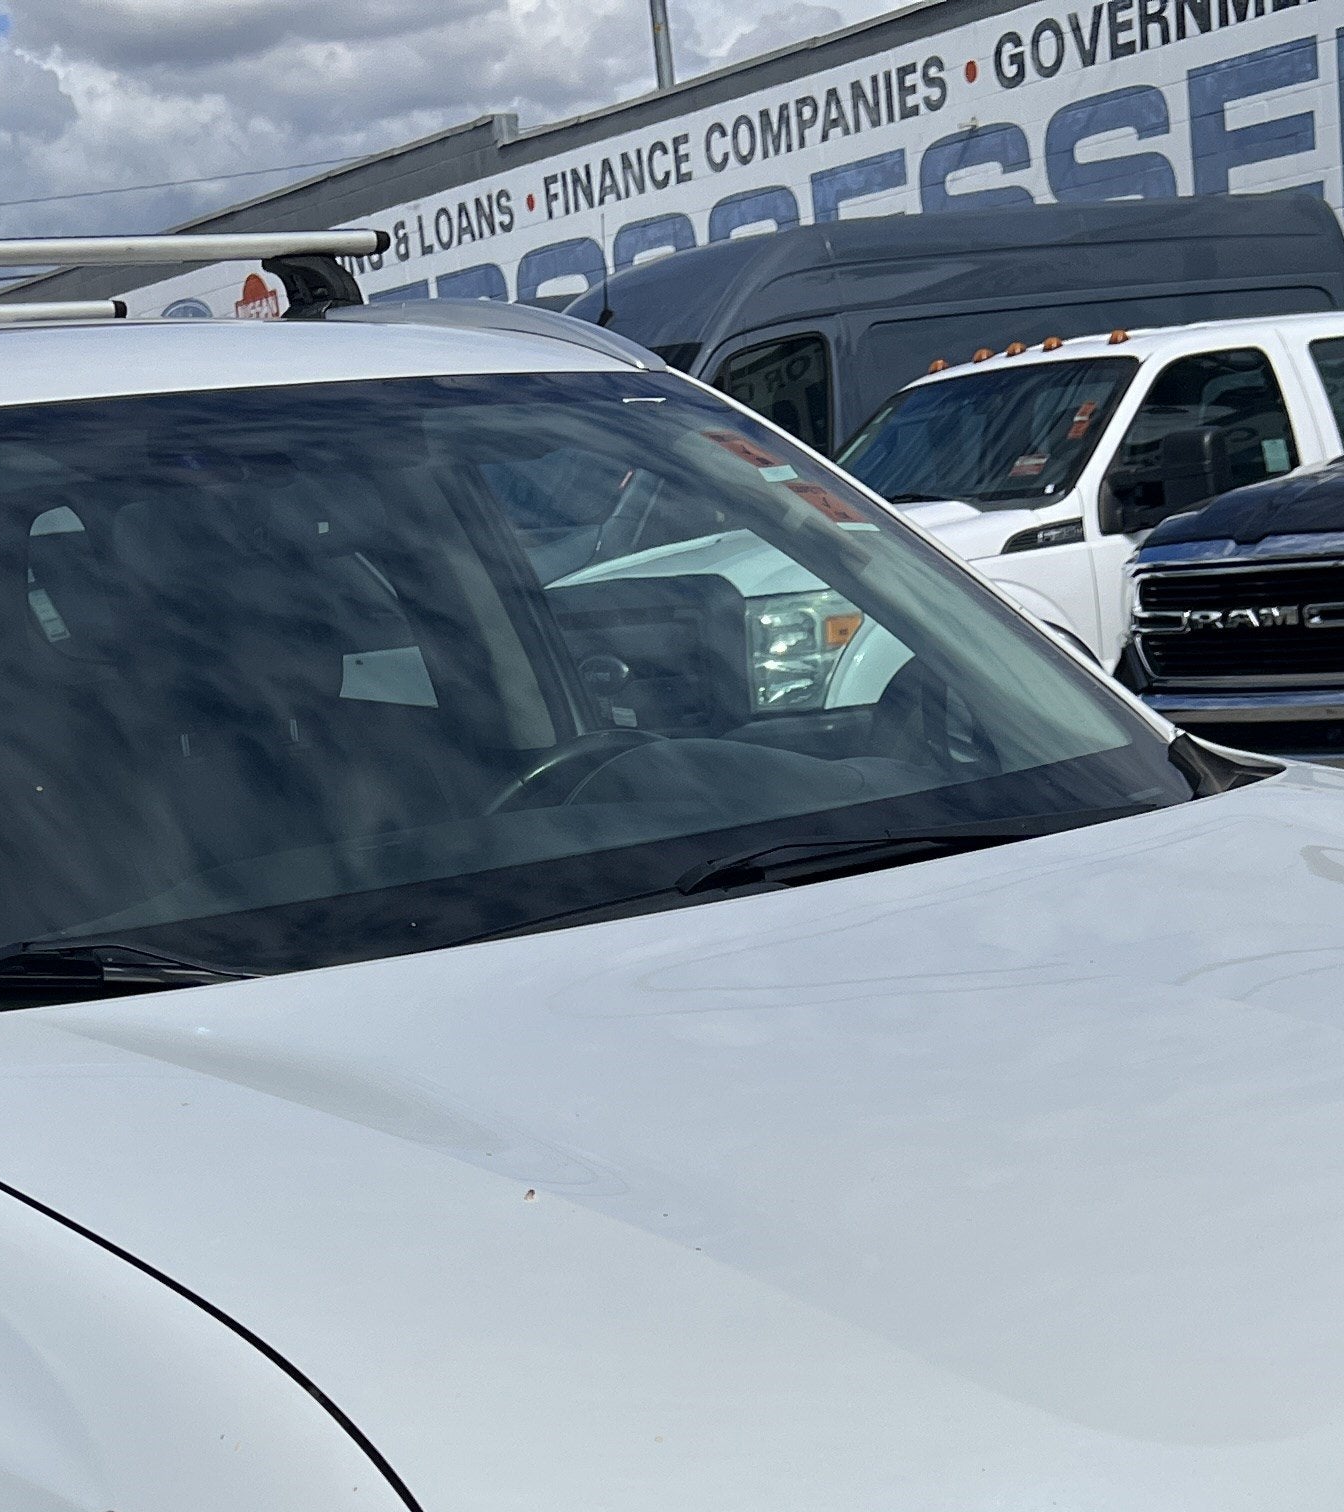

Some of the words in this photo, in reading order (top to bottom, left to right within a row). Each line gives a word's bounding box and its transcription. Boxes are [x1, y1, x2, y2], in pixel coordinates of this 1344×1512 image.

[393, 219, 411, 263] &
[417, 188, 515, 258] LOANS
[542, 132, 694, 220] FINANCE
[704, 54, 948, 173] COMPANIES
[993, 0, 1316, 90] GOVERN
[1191, 605, 1299, 629] RAM
